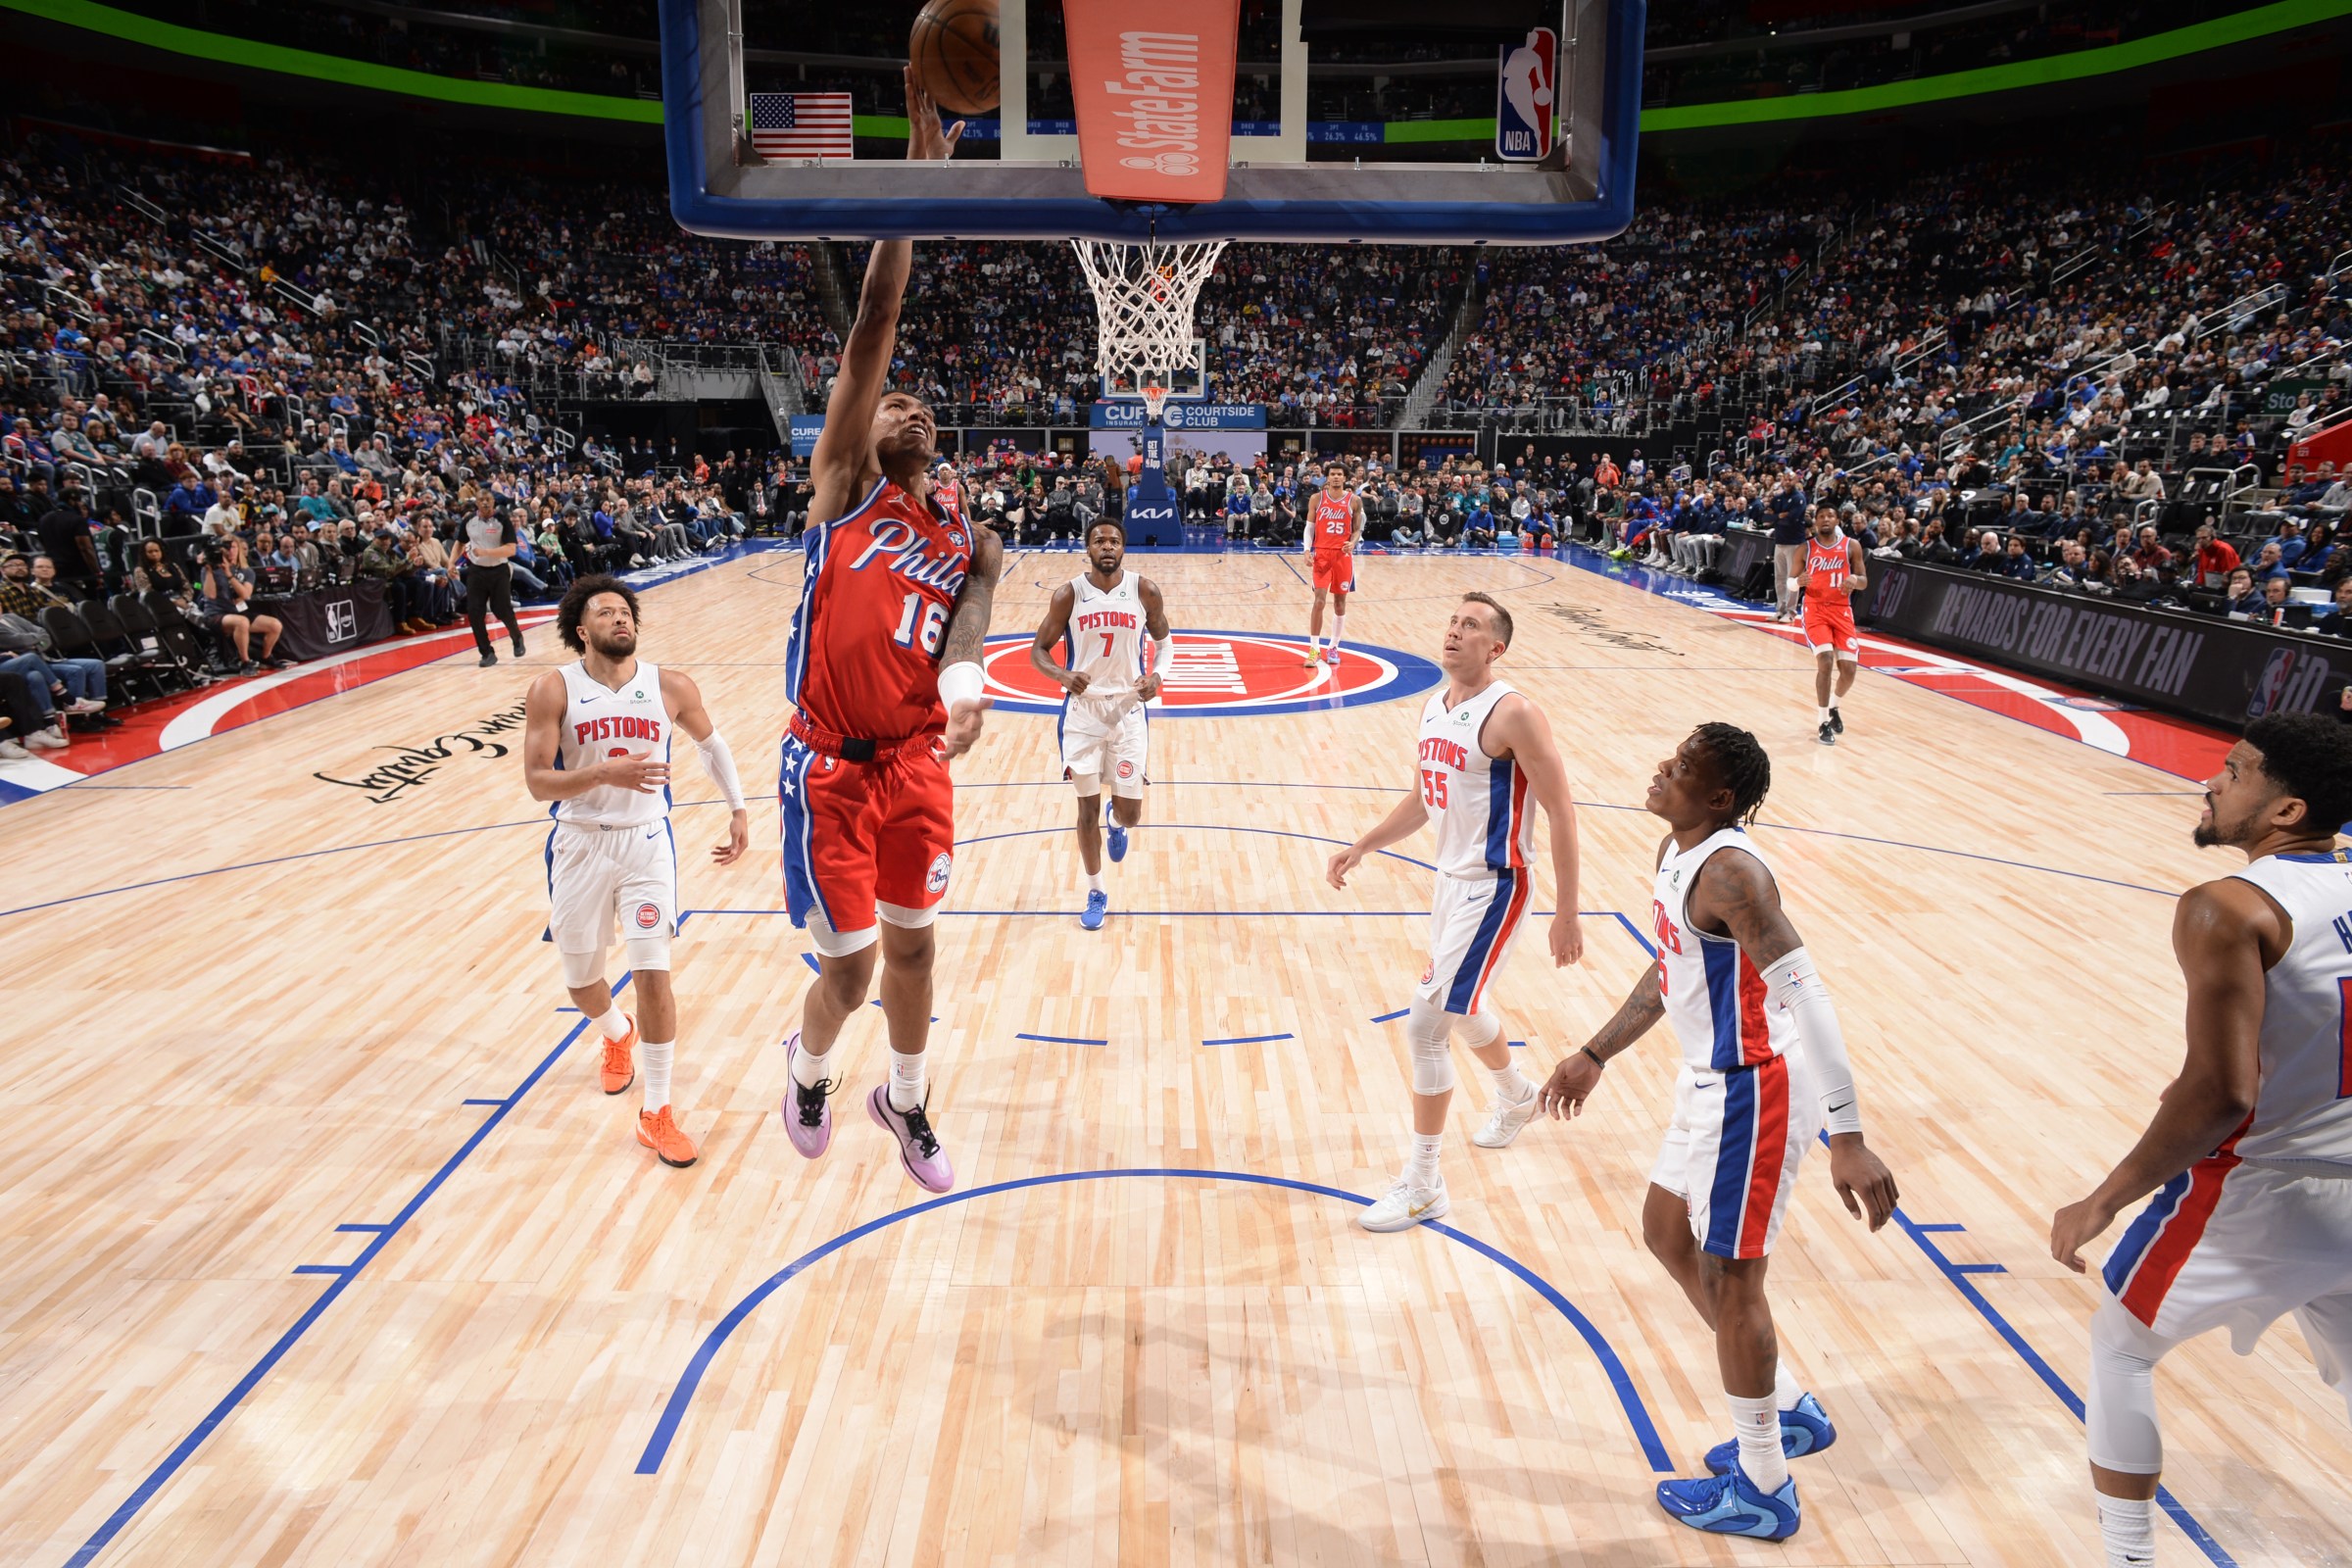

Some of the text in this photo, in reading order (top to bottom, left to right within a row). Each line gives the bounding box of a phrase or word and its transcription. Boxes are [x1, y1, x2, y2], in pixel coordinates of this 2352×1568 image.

[1325, 131, 1346, 141] 26.3%
[1354, 131, 1378, 141] 46.5%
[1504, 129, 1531, 152] NBA
[1186, 406, 1255, 416] COURTSIDE
[1186, 416, 1219, 426] CLUB
[791, 427, 821, 436] CURE
[1148, 440, 1158, 450] GET
[1148, 450, 1158, 459] THE
[1131, 508, 1173, 519] KIA
[1318, 506, 1346, 521] Phila
[1326, 521, 1345, 534] 25
[849, 517, 966, 599] Phila
[1809, 555, 1844, 575] Phila
[1829, 571, 1843, 588] 11
[893, 592, 951, 656] 16
[1077, 611, 1137, 632] PISTONS
[1100, 632, 1114, 658] 7
[1934, 583, 2204, 697] REWARDS FOR EVERY FAN
[574, 716, 661, 746] PISTONS
[1421, 769, 1448, 810] 55
